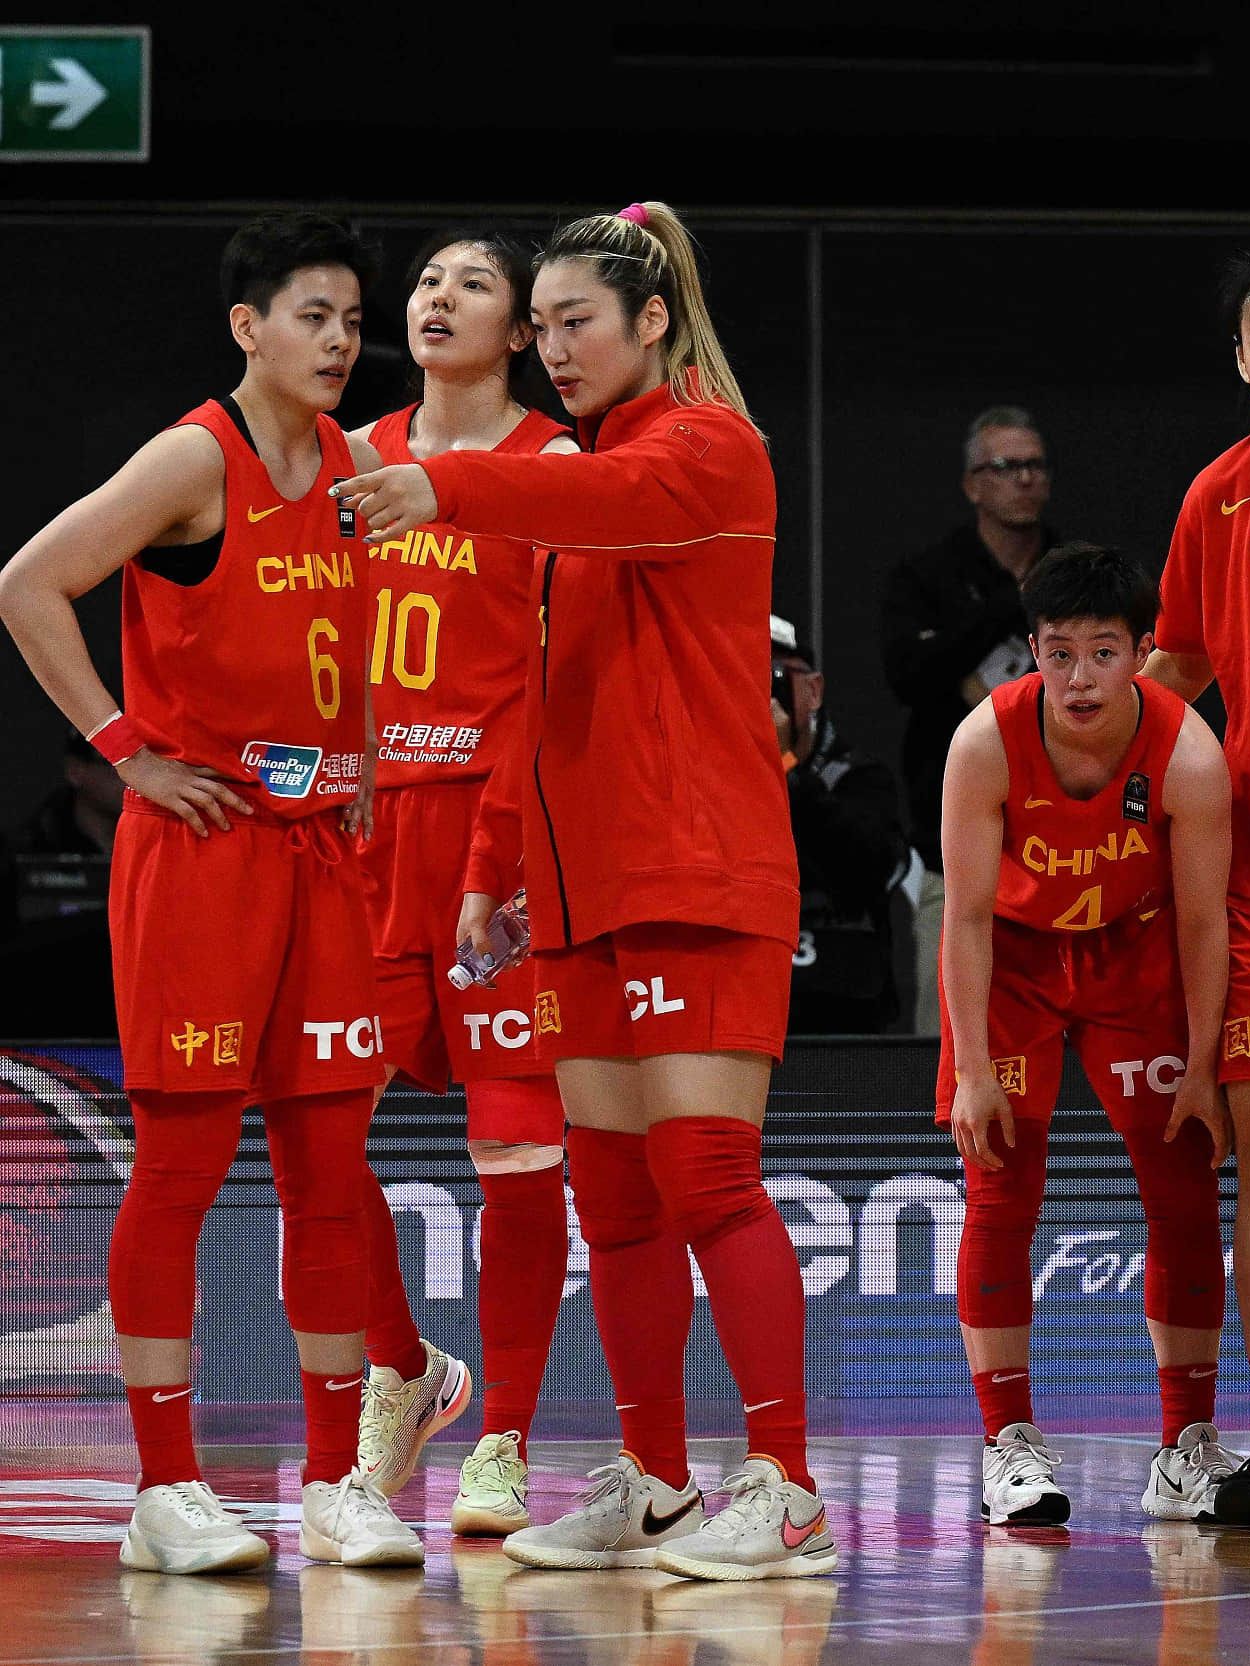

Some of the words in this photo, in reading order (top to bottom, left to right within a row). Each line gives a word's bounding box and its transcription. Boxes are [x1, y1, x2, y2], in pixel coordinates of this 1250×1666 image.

[256, 551, 355, 593] CHINA
[370, 588, 441, 691] 10
[307, 618, 341, 720] 6
[378, 747, 412, 763] China
[413, 749, 472, 765] UnionPay
[382, 722, 483, 750] 中国银联
[248, 752, 312, 777] UnionPay
[1126, 800, 1145, 813] FIBA
[1022, 827, 1150, 876] CHINA
[1051, 884, 1106, 931] 4
[535, 990, 561, 1035] 国
[624, 976, 685, 1021] CL
[170, 1021, 243, 1067] 中国
[463, 1009, 531, 1050] TC
[991, 1055, 1027, 1097] 国
[1110, 1055, 1185, 1097] TC
